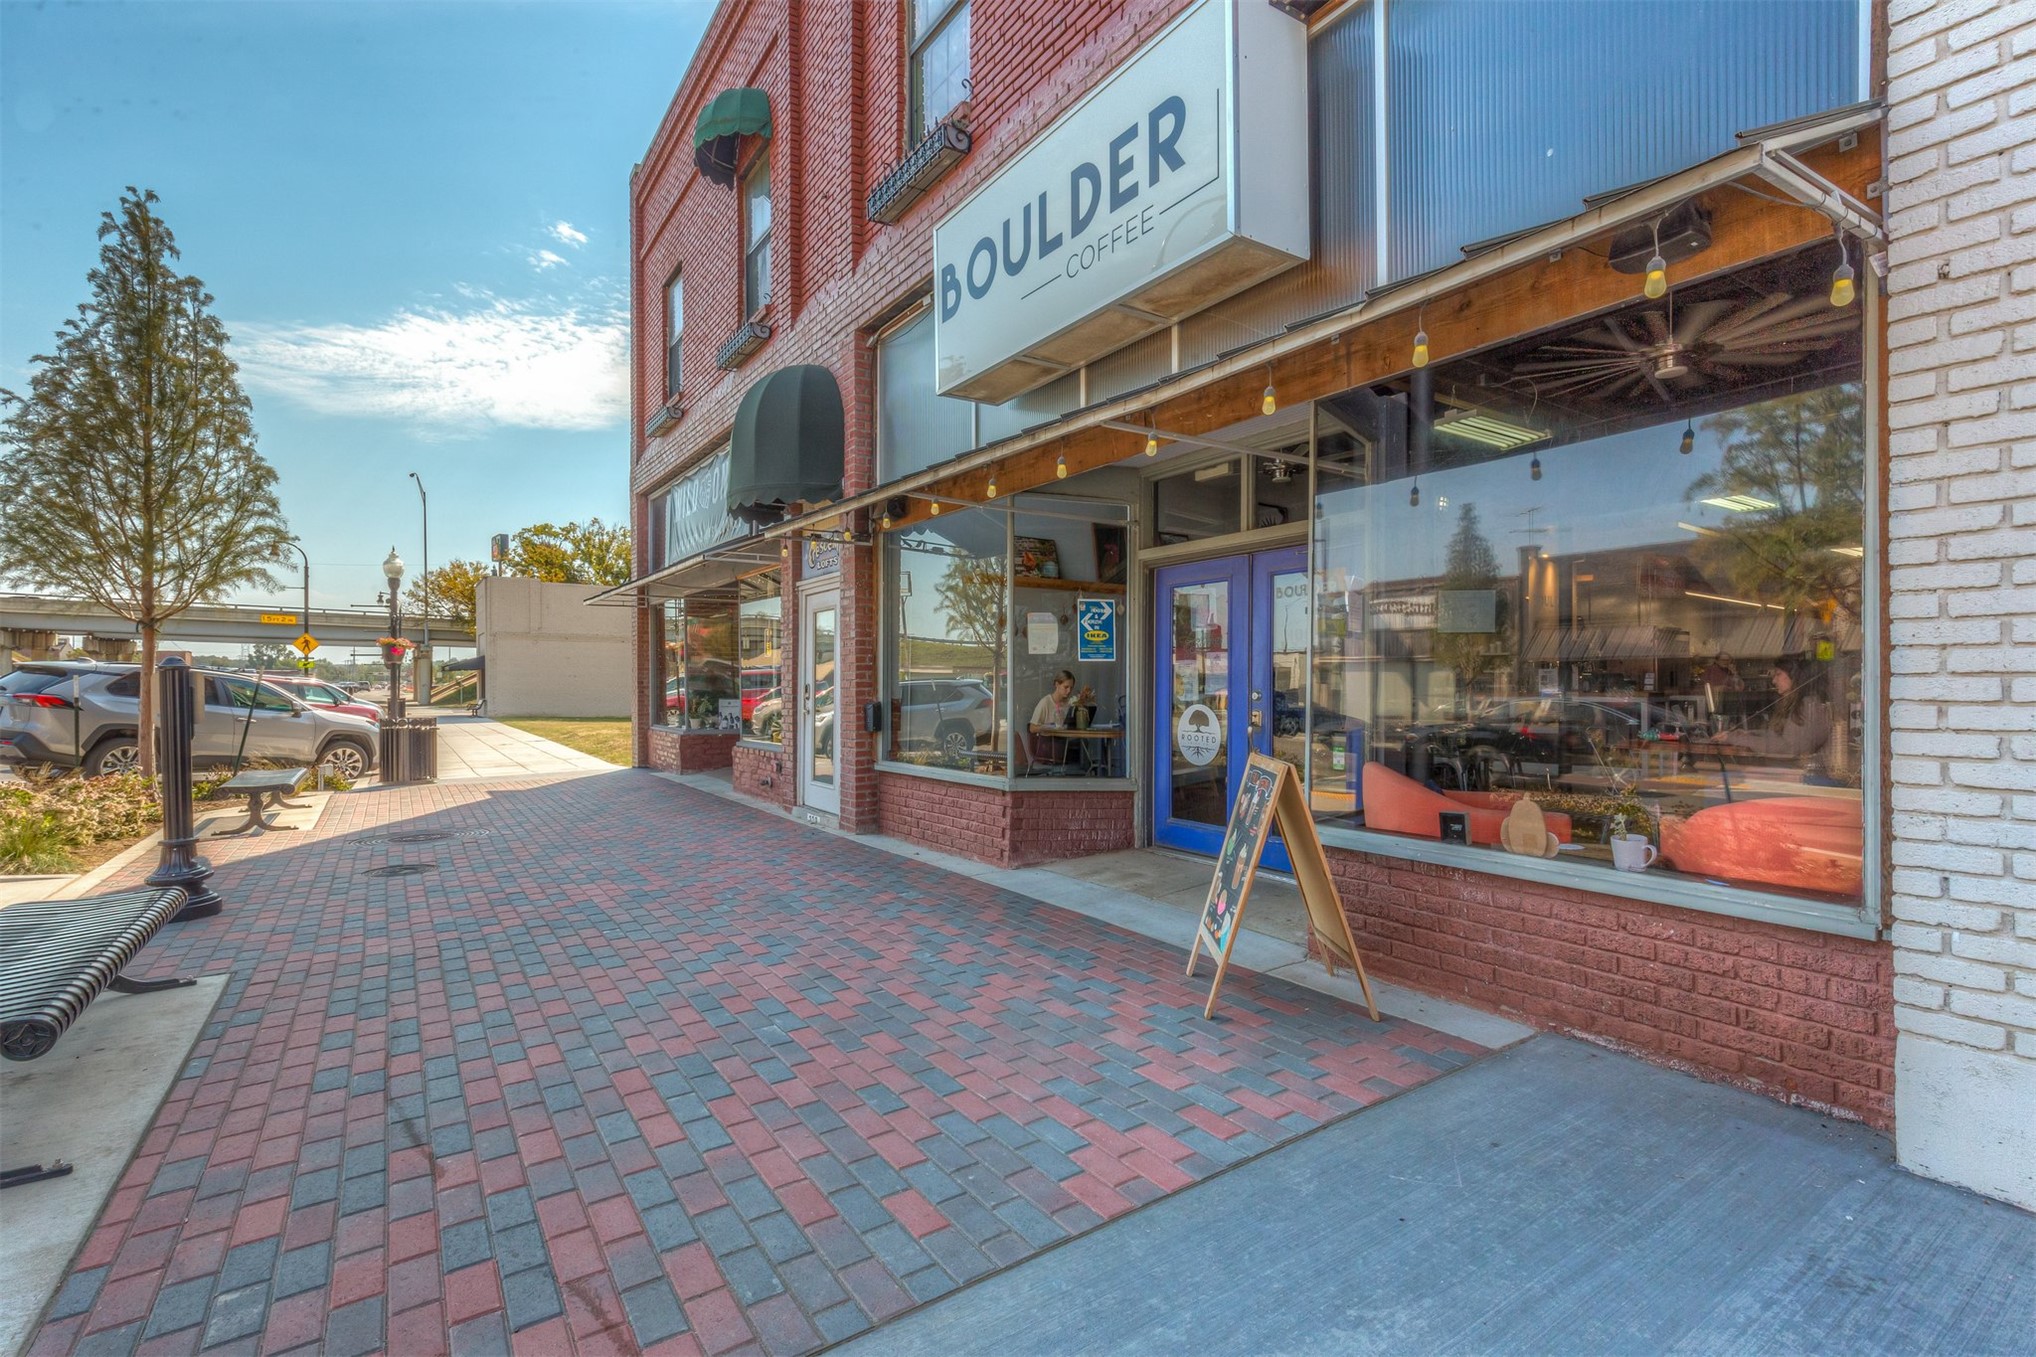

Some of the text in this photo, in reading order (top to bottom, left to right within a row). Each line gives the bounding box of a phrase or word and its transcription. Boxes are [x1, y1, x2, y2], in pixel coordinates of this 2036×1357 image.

[941, 95, 1187, 324] BOULDER
[1065, 204, 1155, 279] COFFEE
[817, 556, 839, 570] LOFTS
[1181, 733, 1217, 744] ROOTED
